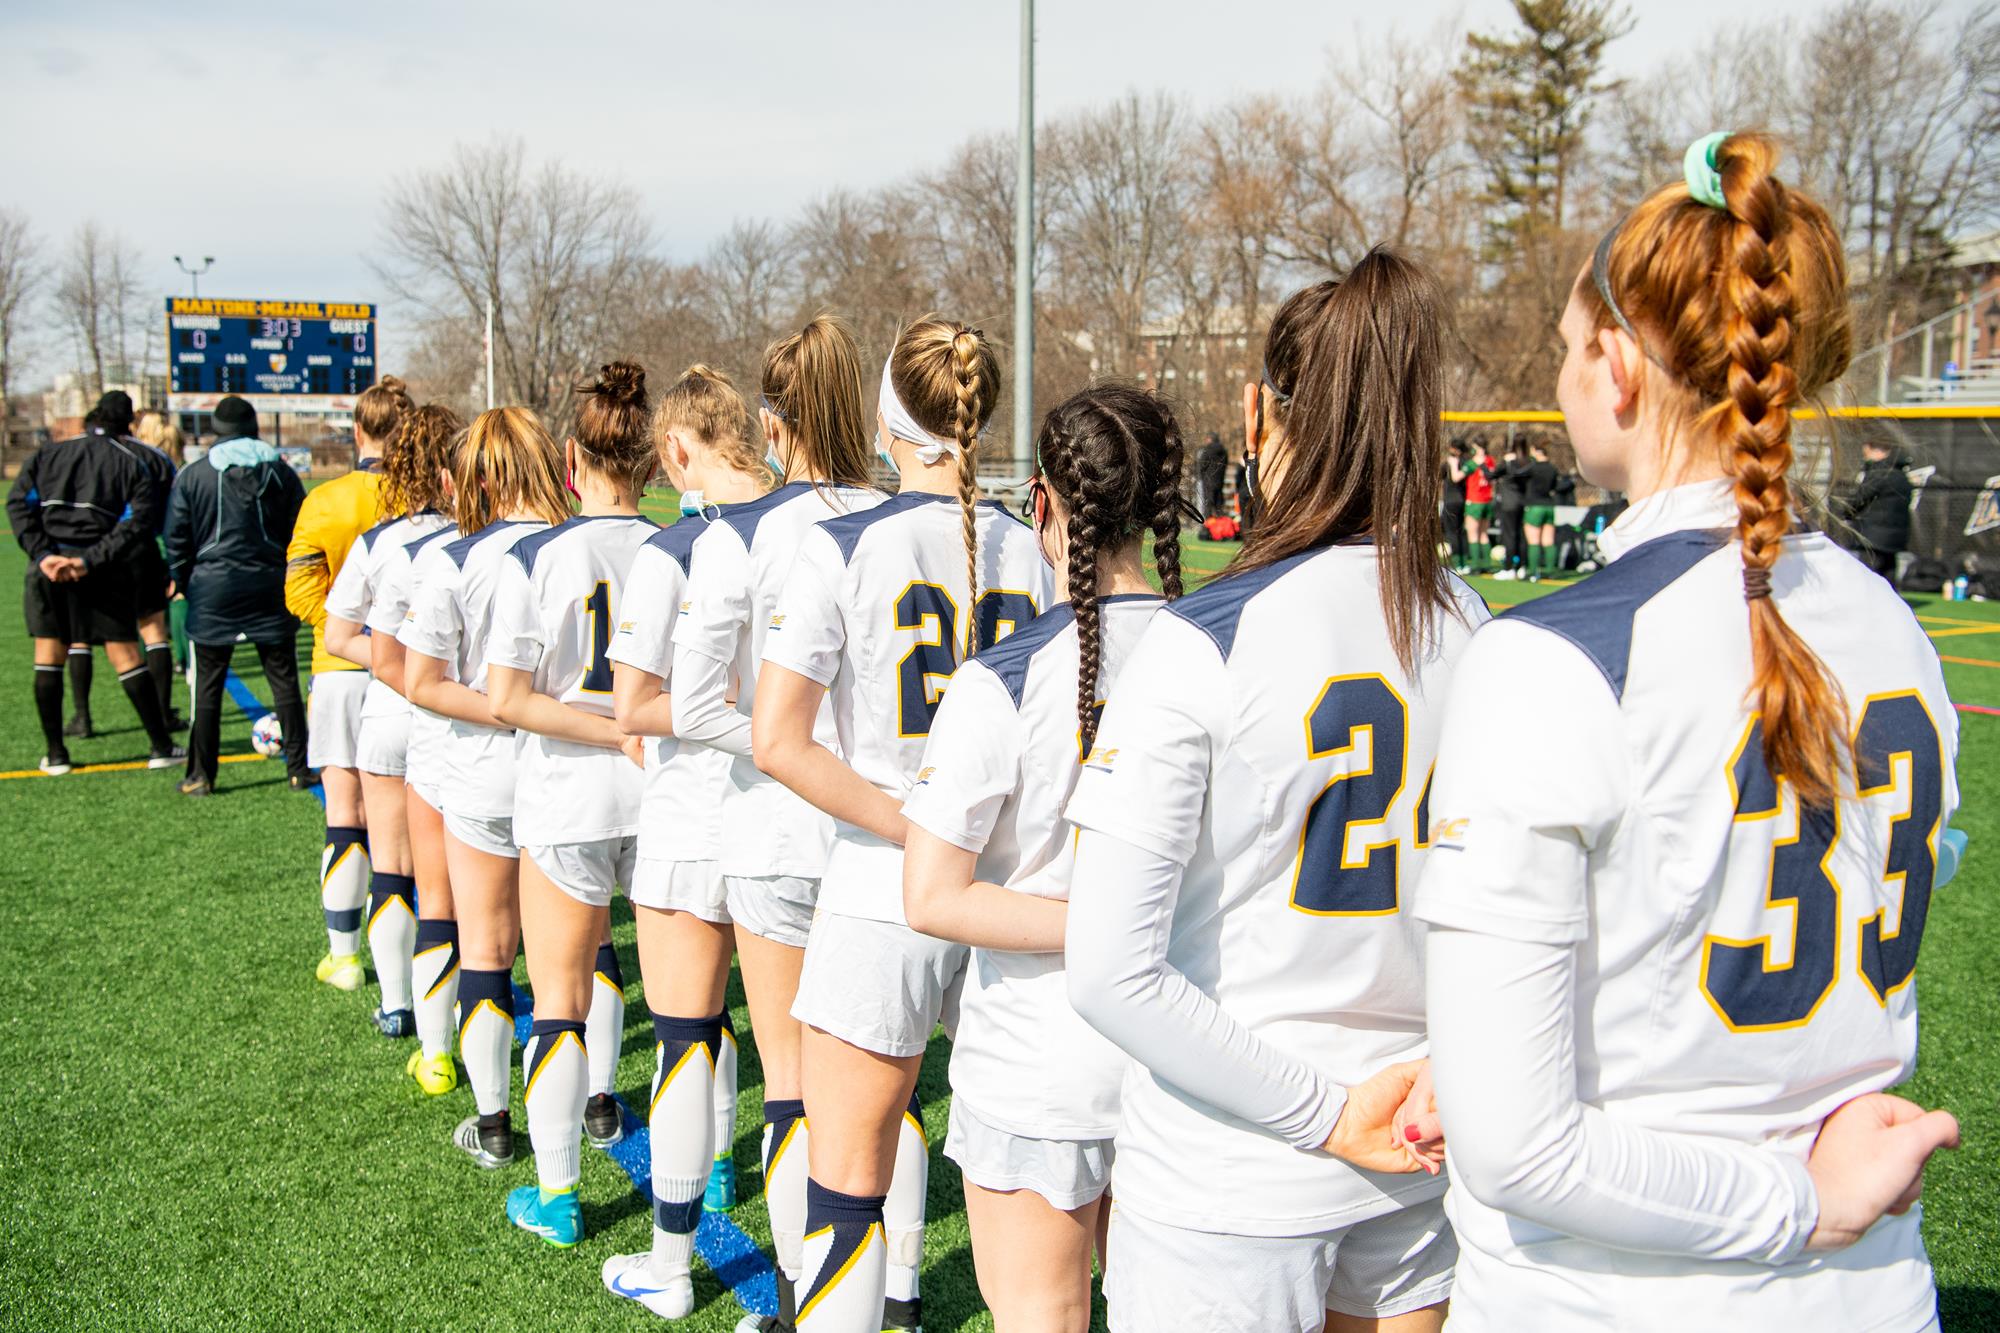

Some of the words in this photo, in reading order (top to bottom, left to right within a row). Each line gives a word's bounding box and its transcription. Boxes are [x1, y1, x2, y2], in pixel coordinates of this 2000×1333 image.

[325, 304, 370, 319] FIELD
[329, 319, 369, 334] GUEST
[193, 330, 207, 349] 0
[353, 334, 366, 353] 0
[1289, 673, 1436, 916] 2
[1699, 688, 1945, 1033] 33
